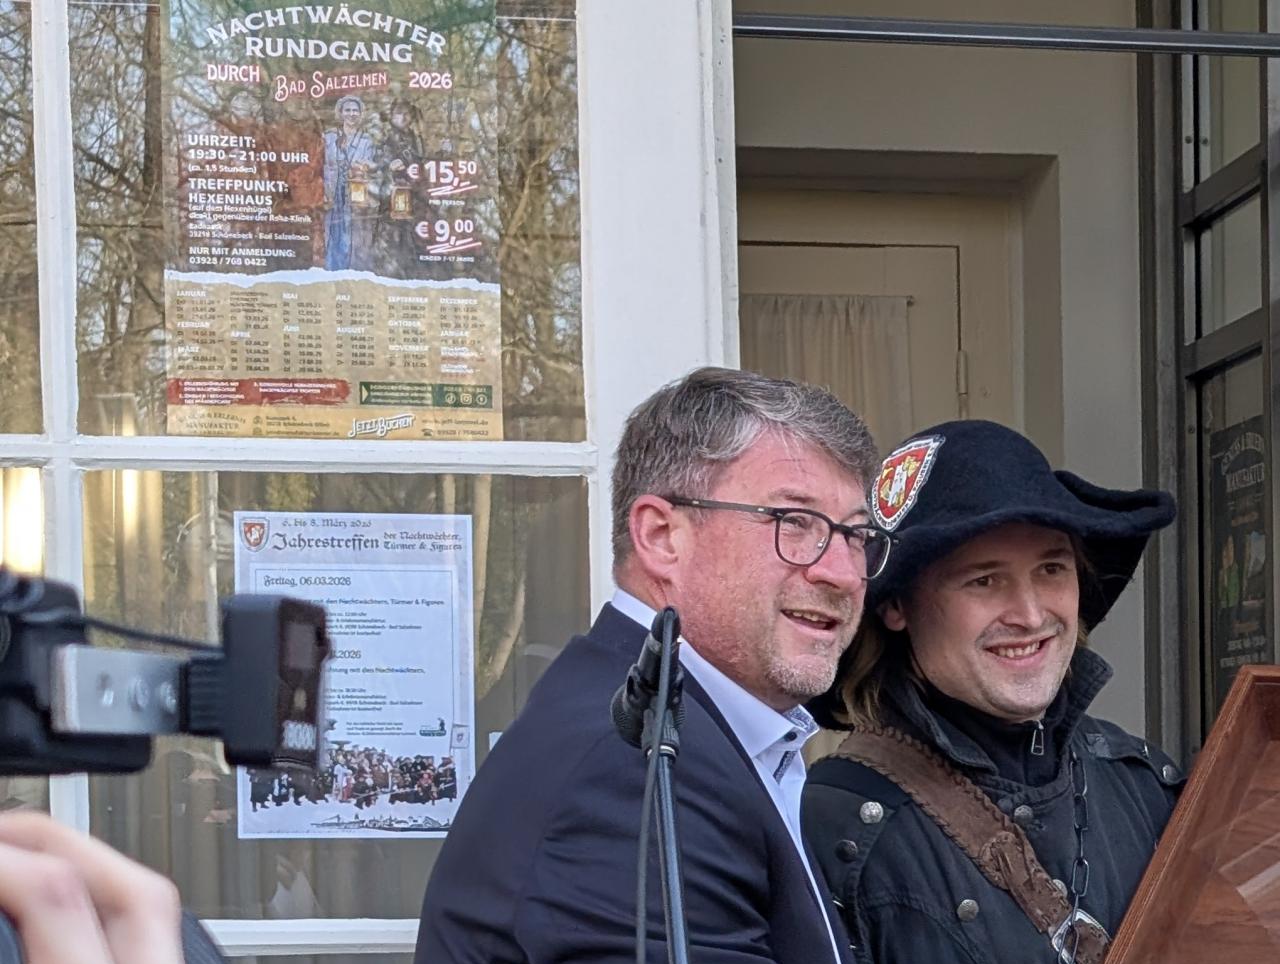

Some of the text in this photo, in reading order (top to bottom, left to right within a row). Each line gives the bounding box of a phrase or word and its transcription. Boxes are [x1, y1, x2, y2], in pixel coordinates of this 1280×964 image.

[206, 3, 446, 54] NACHTWÄCHTER
[245, 37, 413, 63] RUNDGANG
[207, 64, 260, 82] DURCH
[408, 72, 452, 88] 2026
[188, 134, 256, 148] UHRZEIT:
[188, 149, 225, 160] 19:30
[239, 151, 276, 162] 21:00
[281, 152, 309, 163] UHR
[407, 163, 419, 179] €
[188, 178, 288, 193] TREFFPUNKT:
[188, 193, 273, 205] HEXENHAUS
[415, 221, 429, 238] €
[189, 246, 296, 258] NUR MIT ANMELDUNG:
[189, 257, 218, 265] 03928
[294, 518, 307, 527] bis
[272, 533, 379, 550] Jahrestreffen
[300, 576, 351, 586] 06.03.2026
